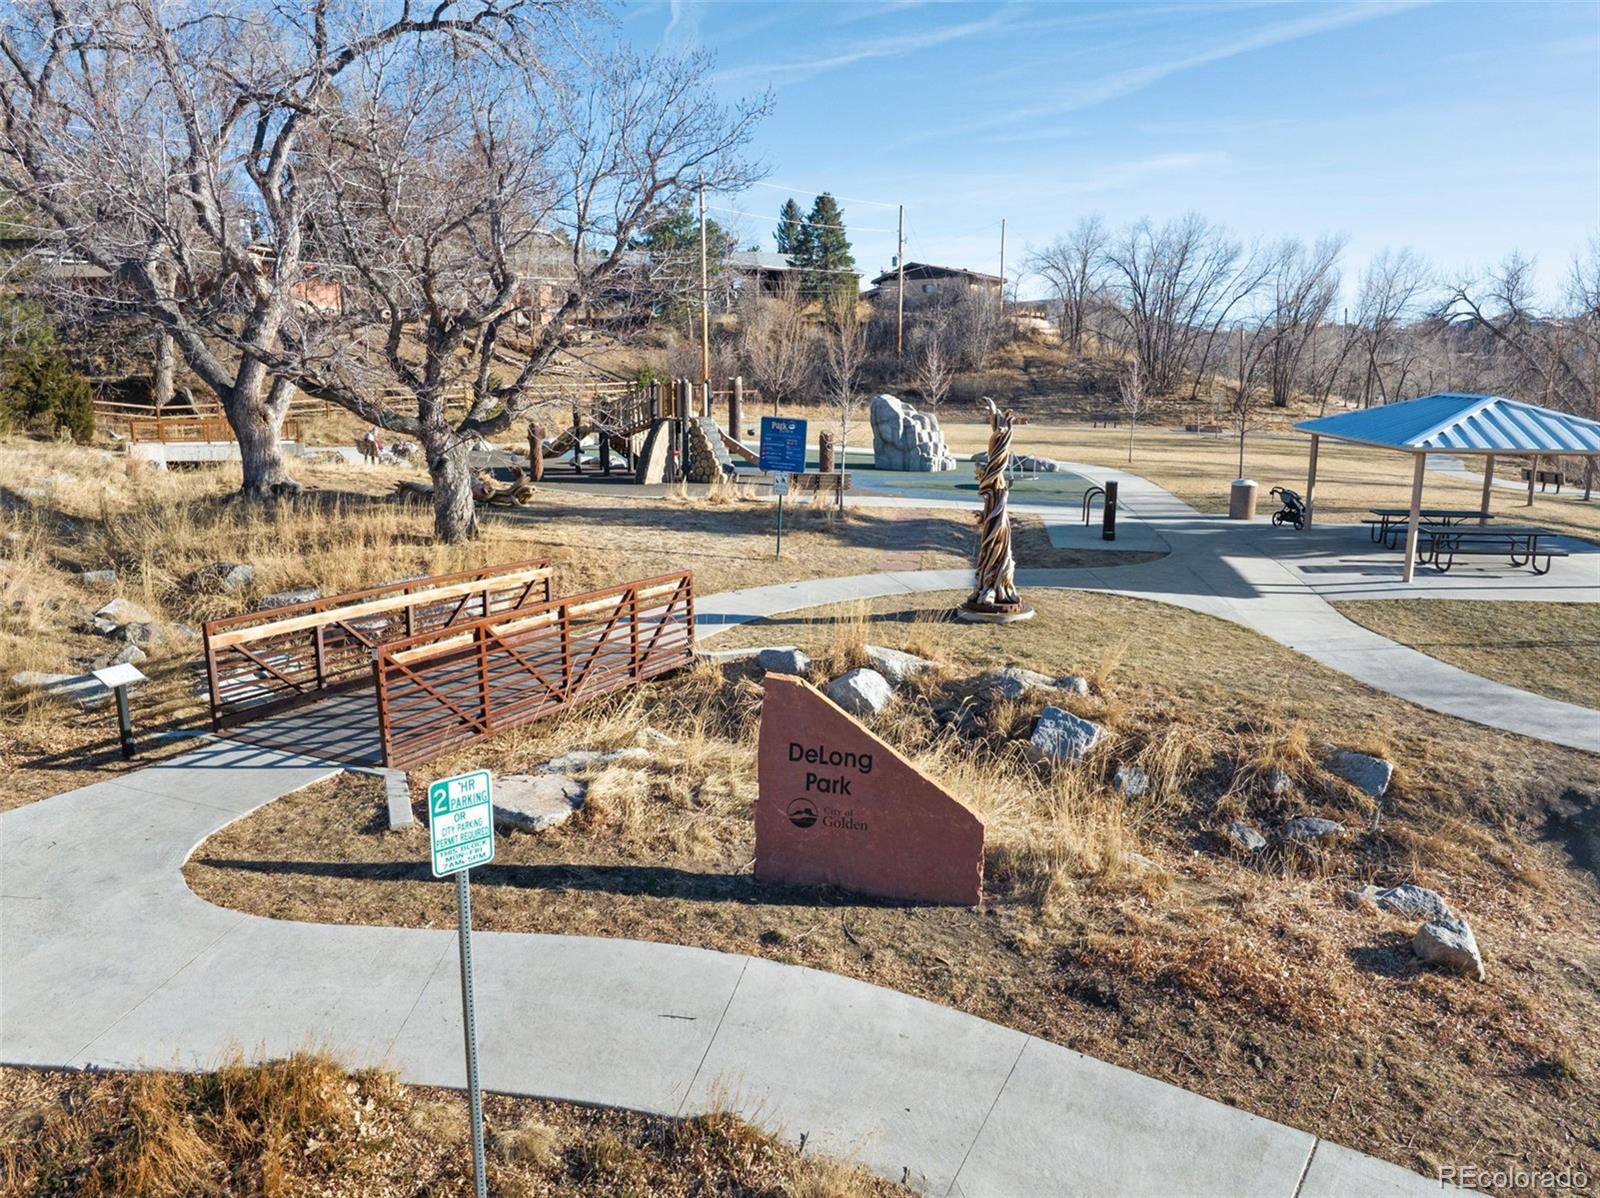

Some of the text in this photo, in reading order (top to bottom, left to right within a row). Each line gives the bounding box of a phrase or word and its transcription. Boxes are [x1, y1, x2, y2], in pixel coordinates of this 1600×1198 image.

[788, 742, 873, 774] DeLong
[805, 772, 852, 796] Park
[433, 779, 475, 814] 2 HR
[450, 790, 487, 810] PARKING
[453, 811, 466, 823] OR
[823, 806, 855, 817] City of
[441, 818, 483, 837] CITY PARKING
[822, 816, 868, 831] Golden
[436, 826, 489, 848] PERMIT REQUIRED
[440, 840, 487, 859] THIS BLOCK
